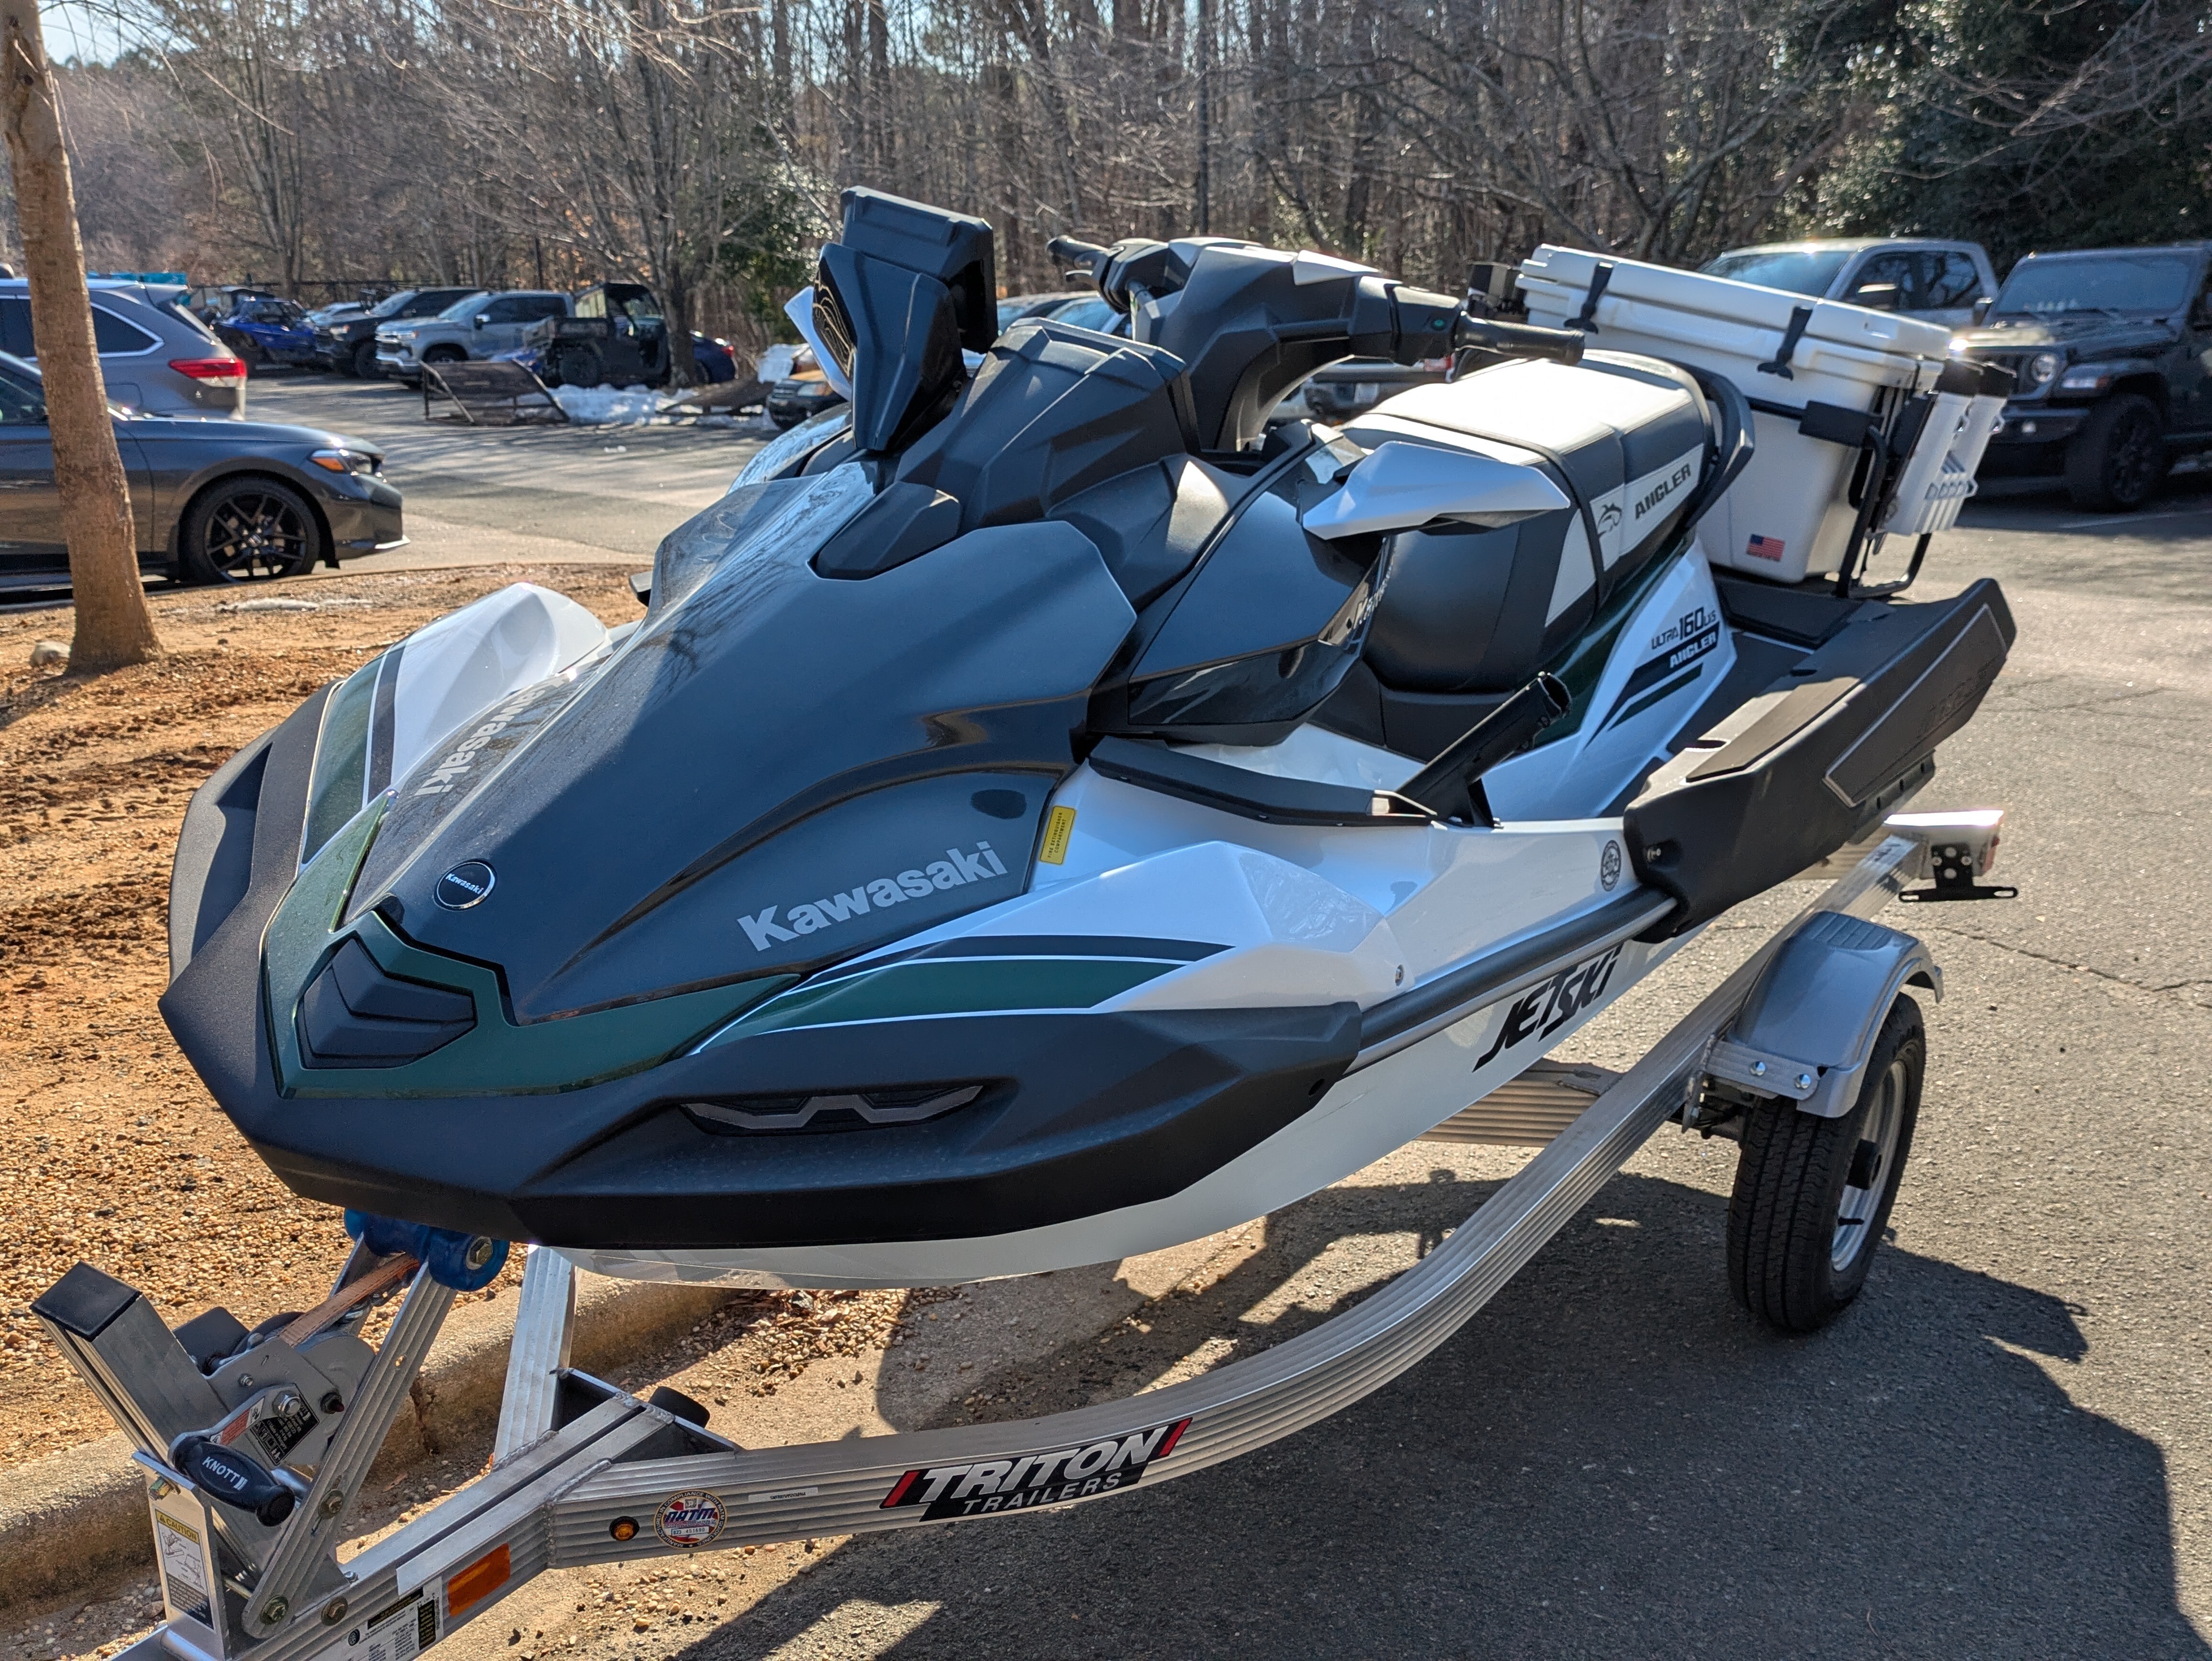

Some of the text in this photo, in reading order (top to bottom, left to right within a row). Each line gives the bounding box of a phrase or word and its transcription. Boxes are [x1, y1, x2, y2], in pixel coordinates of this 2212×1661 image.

[1635, 464, 1691, 520] ANGLER
[1679, 607, 1704, 640] 160
[1670, 631, 1716, 668] ANGLER
[414, 673, 569, 796] Kawasaki
[445, 873, 484, 894] Kawasaki
[736, 841, 1008, 952] Kawasaki
[202, 1456, 240, 1483] KNOTT
[919, 1425, 1169, 1502] TRITON
[664, 1492, 704, 1506] COMPLIANCE
[705, 1494, 719, 1506] WITH
[963, 1472, 1121, 1514] TRAILERS
[166, 1518, 197, 1540] CAUTION
[656, 1513, 684, 1548] MANUFACTURED
[664, 1507, 716, 1523] NATM
